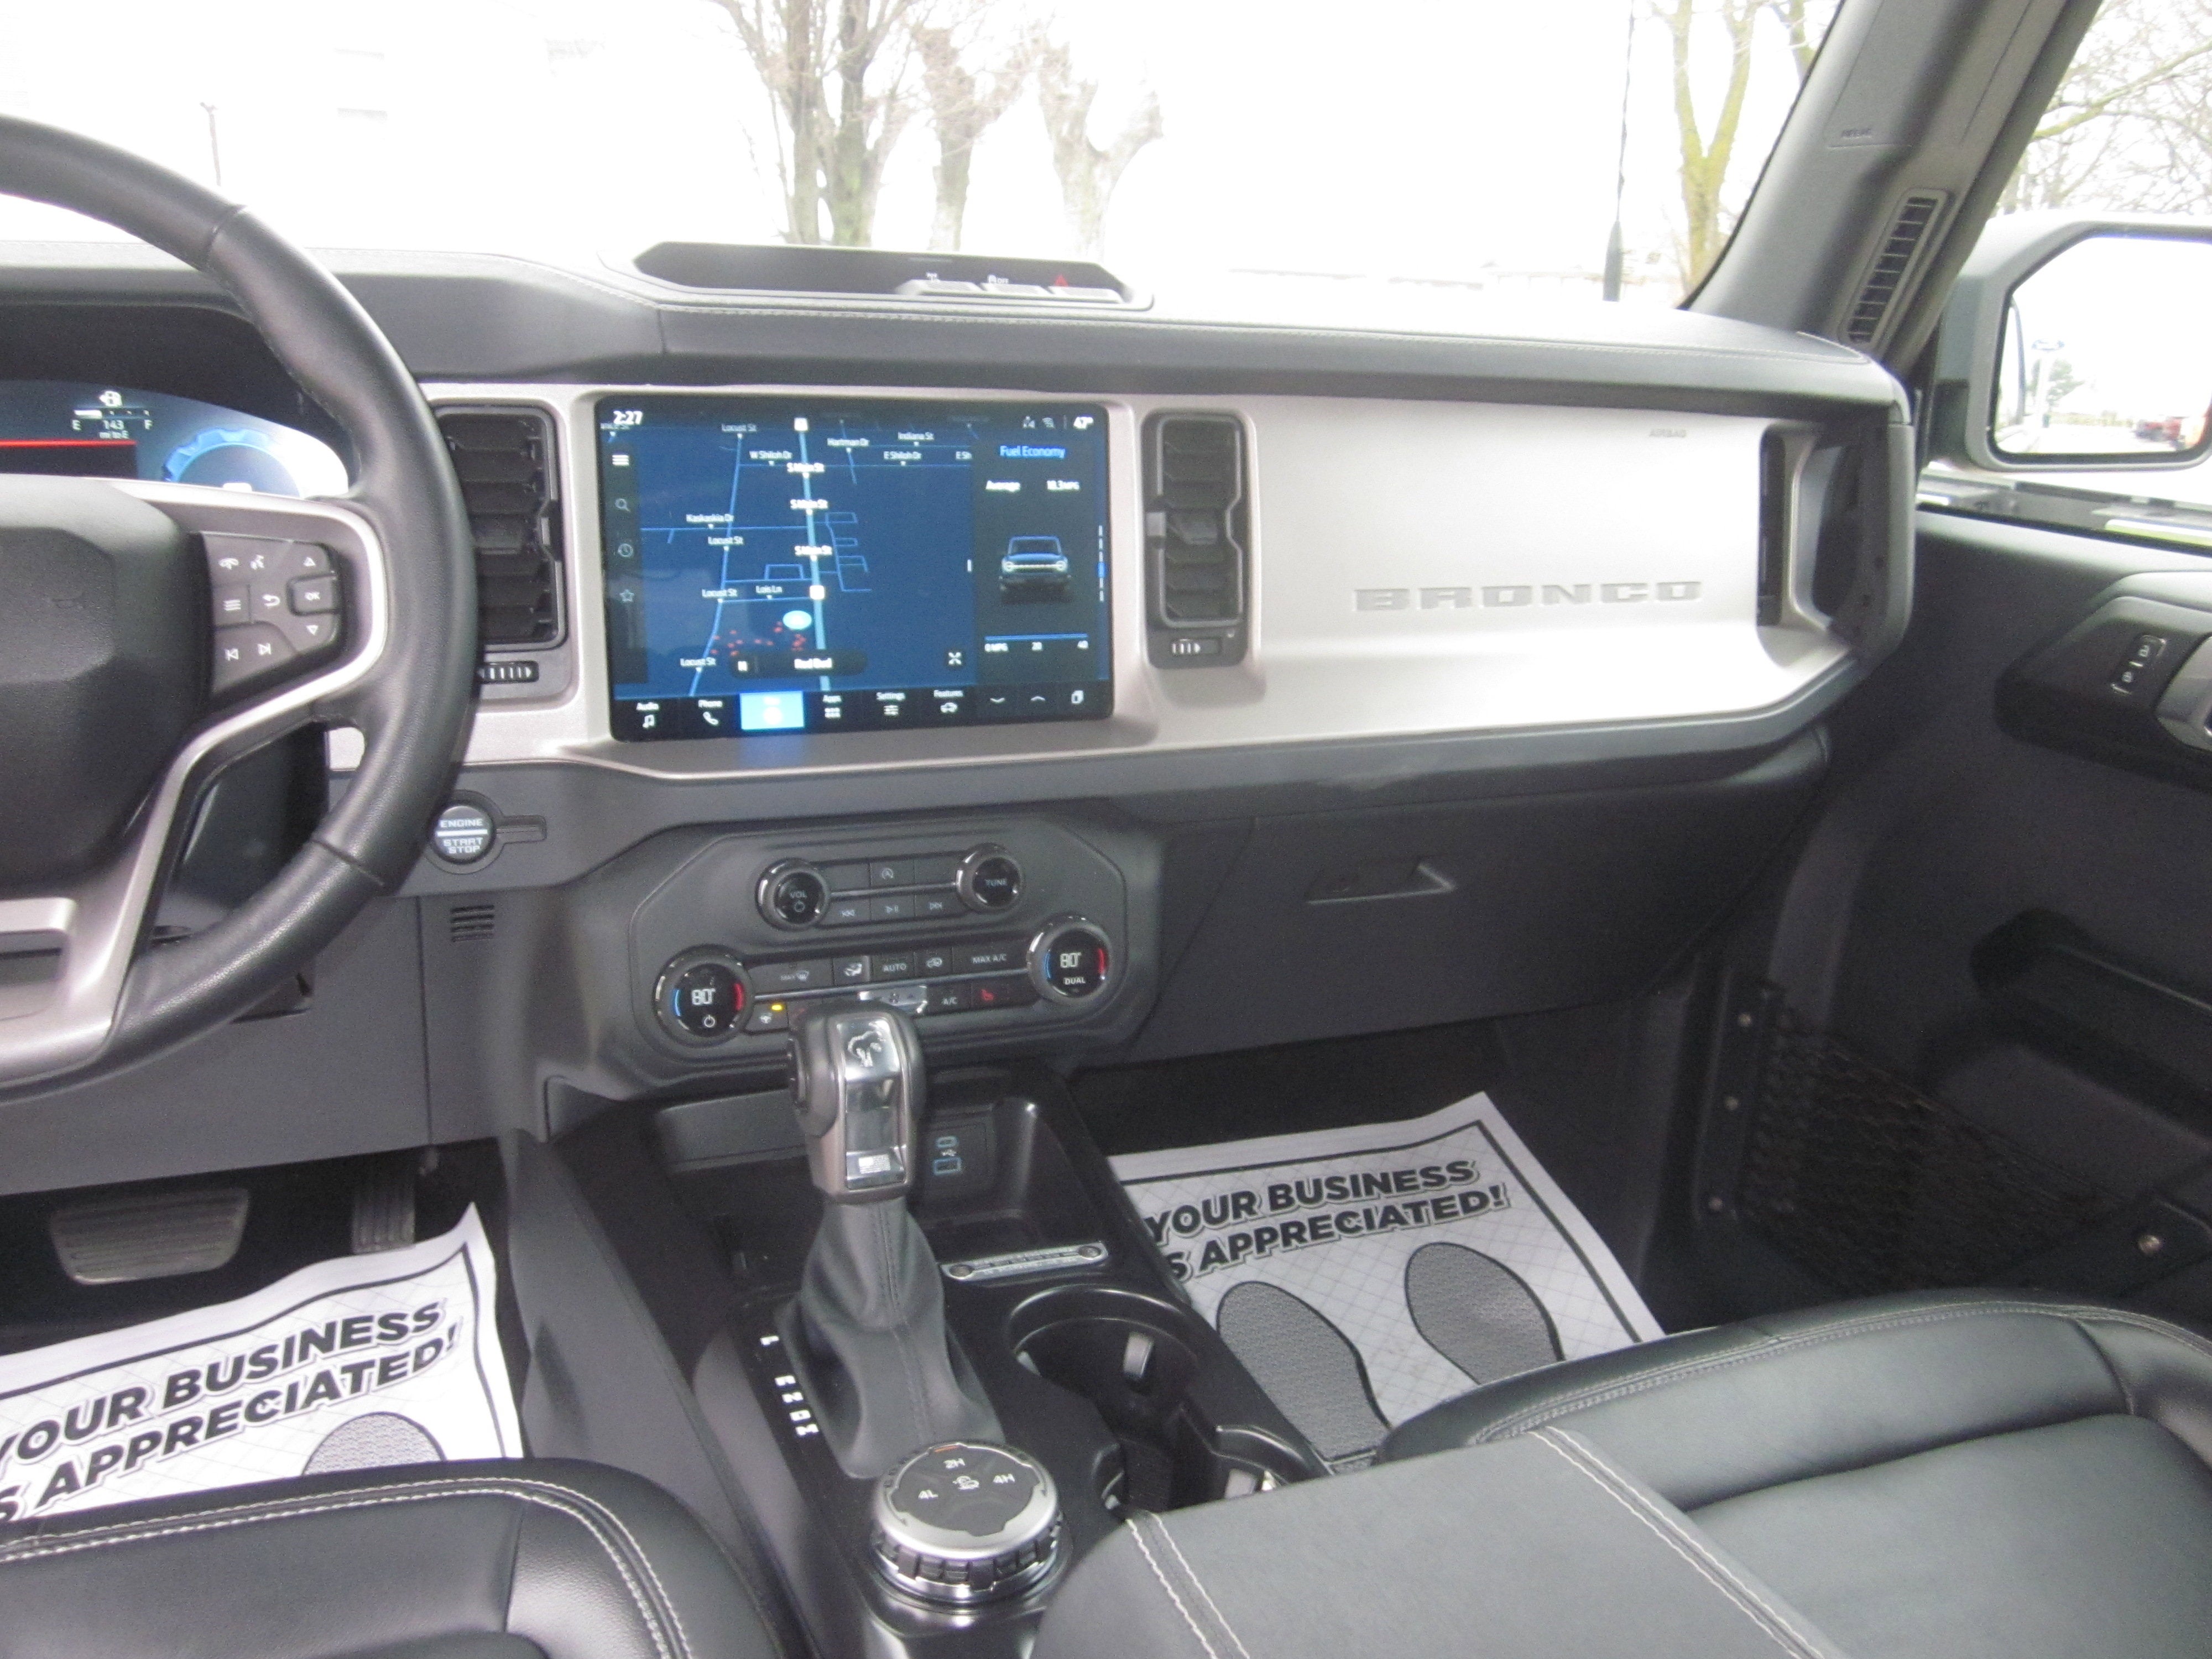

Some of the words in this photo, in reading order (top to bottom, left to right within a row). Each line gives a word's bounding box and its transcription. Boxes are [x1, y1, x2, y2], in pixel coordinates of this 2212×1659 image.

[613, 411, 643, 425] 2:27
[72, 420, 81, 431] E
[103, 420, 124, 430] 143
[144, 419, 153, 430] F
[1000, 445, 1020, 457] Fuel
[1022, 446, 1066, 458] Economy
[305, 592, 320, 601] OK
[1353, 581, 1702, 612] BRONCO
[877, 692, 905, 702] Settings
[933, 690, 963, 698] Features
[636, 702, 659, 711] Audio
[698, 700, 723, 708] Phone
[440, 818, 483, 828] ENGINE
[444, 837, 483, 847] START
[447, 846, 481, 854] STOP
[790, 891, 807, 899] VOL
[972, 955, 990, 963] MAX
[991, 953, 1006, 962] A/C
[884, 963, 906, 972] AUTO
[1065, 977, 1086, 985] DUAL
[942, 997, 957, 1005] A/C
[1144, 1190, 1259, 1243] YOUR
[1267, 1160, 1475, 1212] BUSINESS
[1163, 1251, 1189, 1279] S
[1199, 1183, 1505, 1271] APPRECIATED!
[163, 1301, 441, 1410] BUSINESS
[35, 1322, 457, 1510] APPRECIATED!
